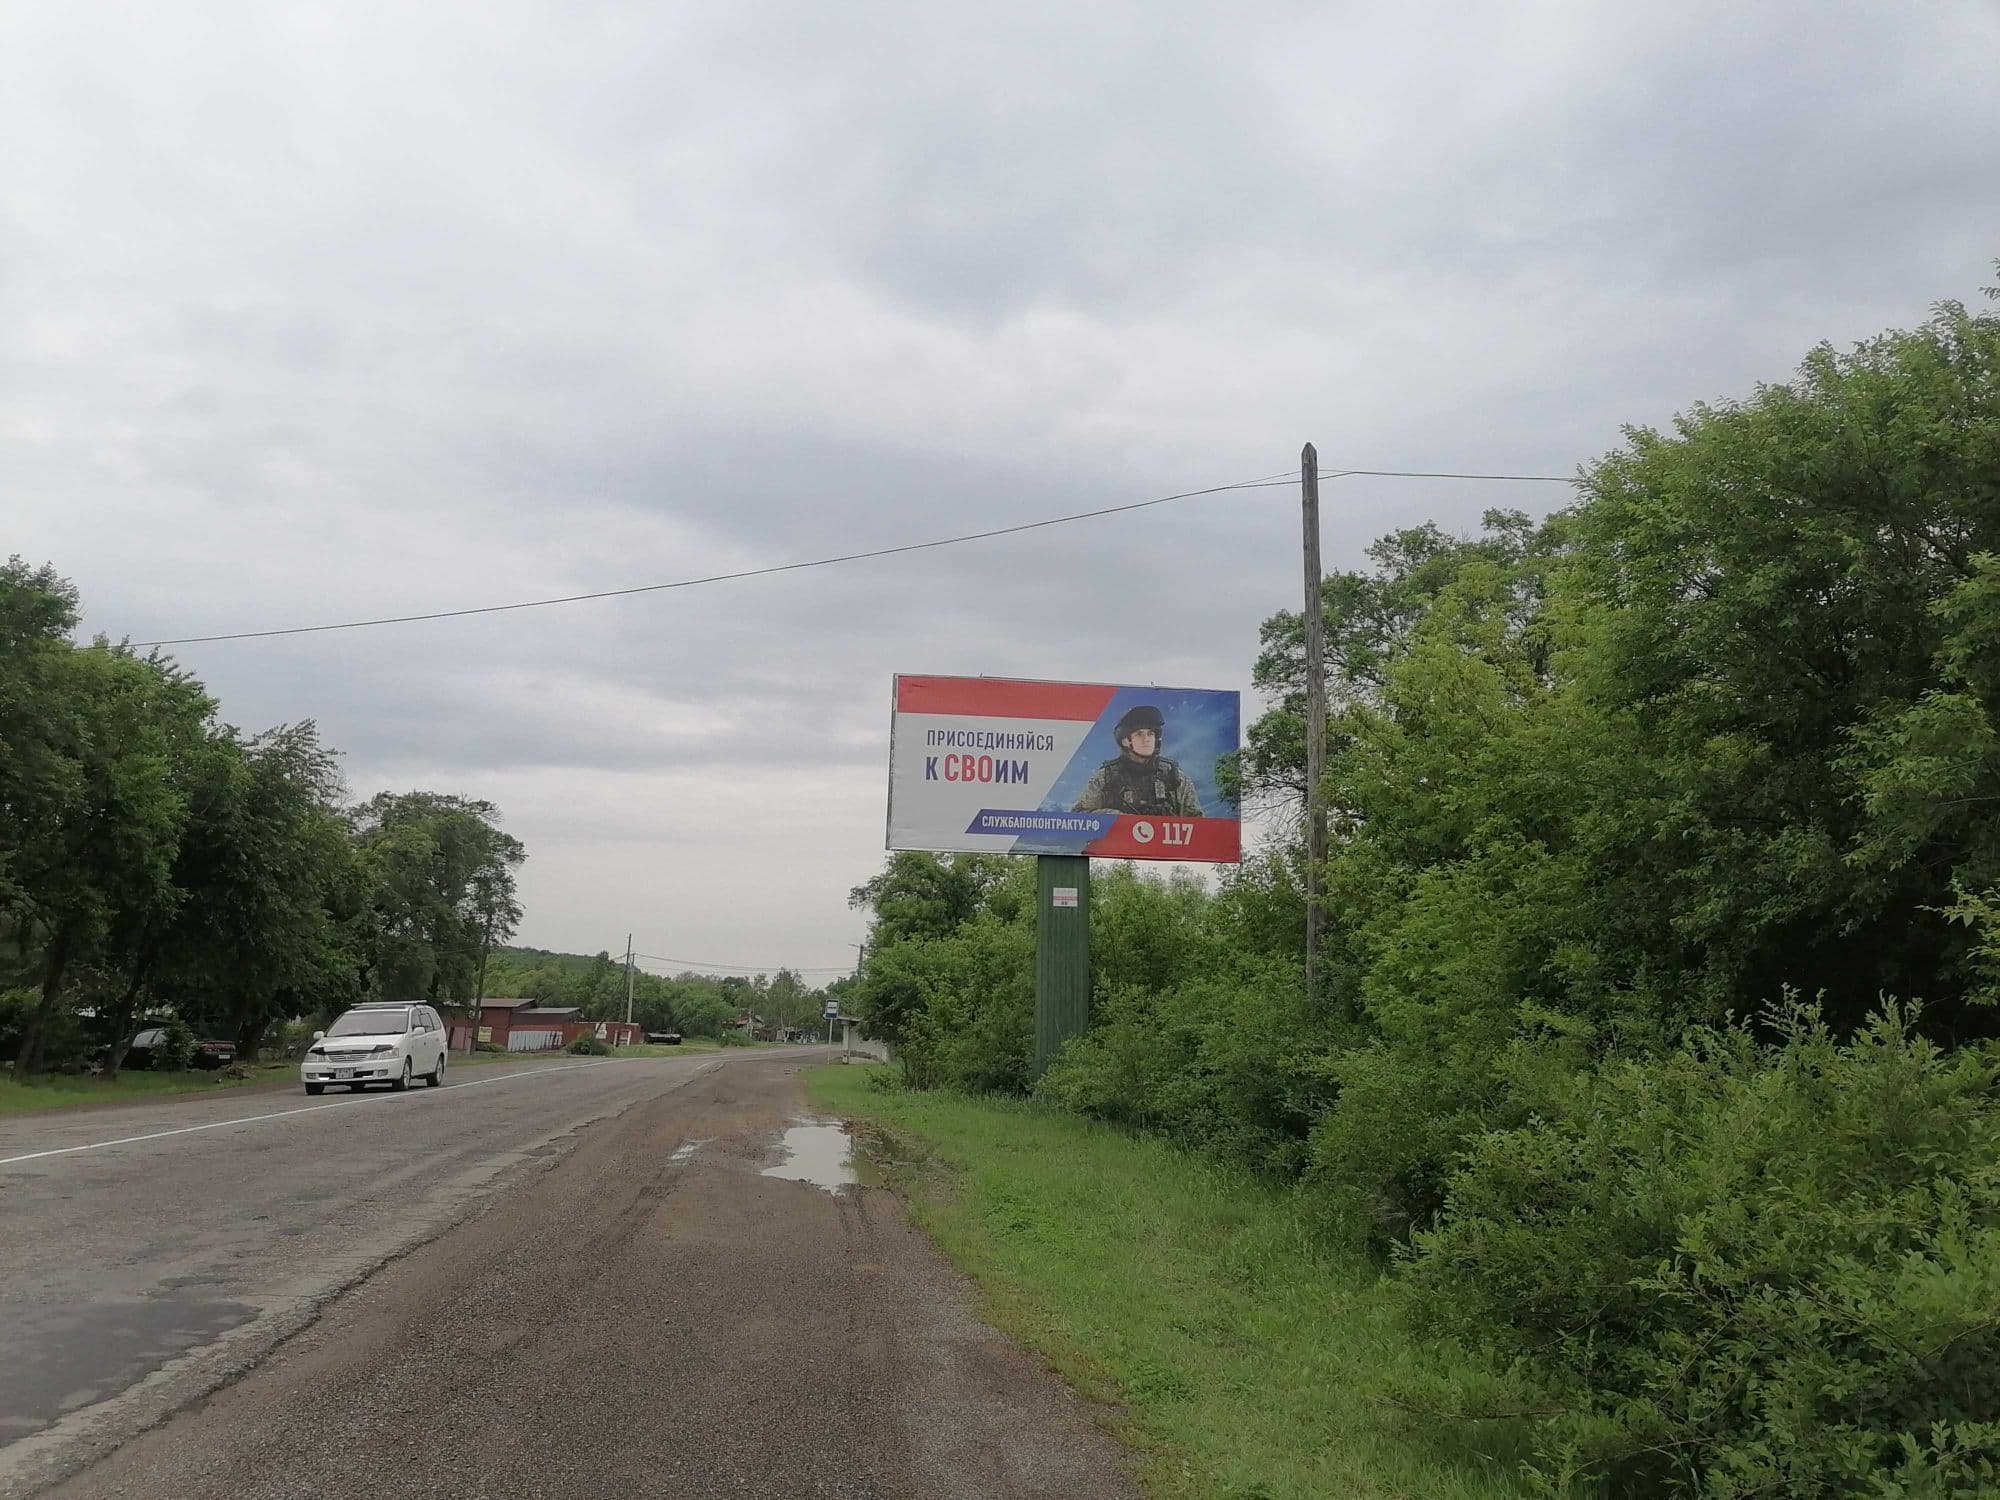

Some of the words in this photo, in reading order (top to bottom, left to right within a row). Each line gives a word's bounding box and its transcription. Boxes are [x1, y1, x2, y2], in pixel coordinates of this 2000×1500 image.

[926, 730, 1054, 751] ПРИСОЕДИНЯЙСЯ
[925, 756, 938, 781] К
[982, 815, 1100, 832] СЛУЖБАПОКОНТРАКТУ.РФ
[1162, 822, 1193, 845] 117
